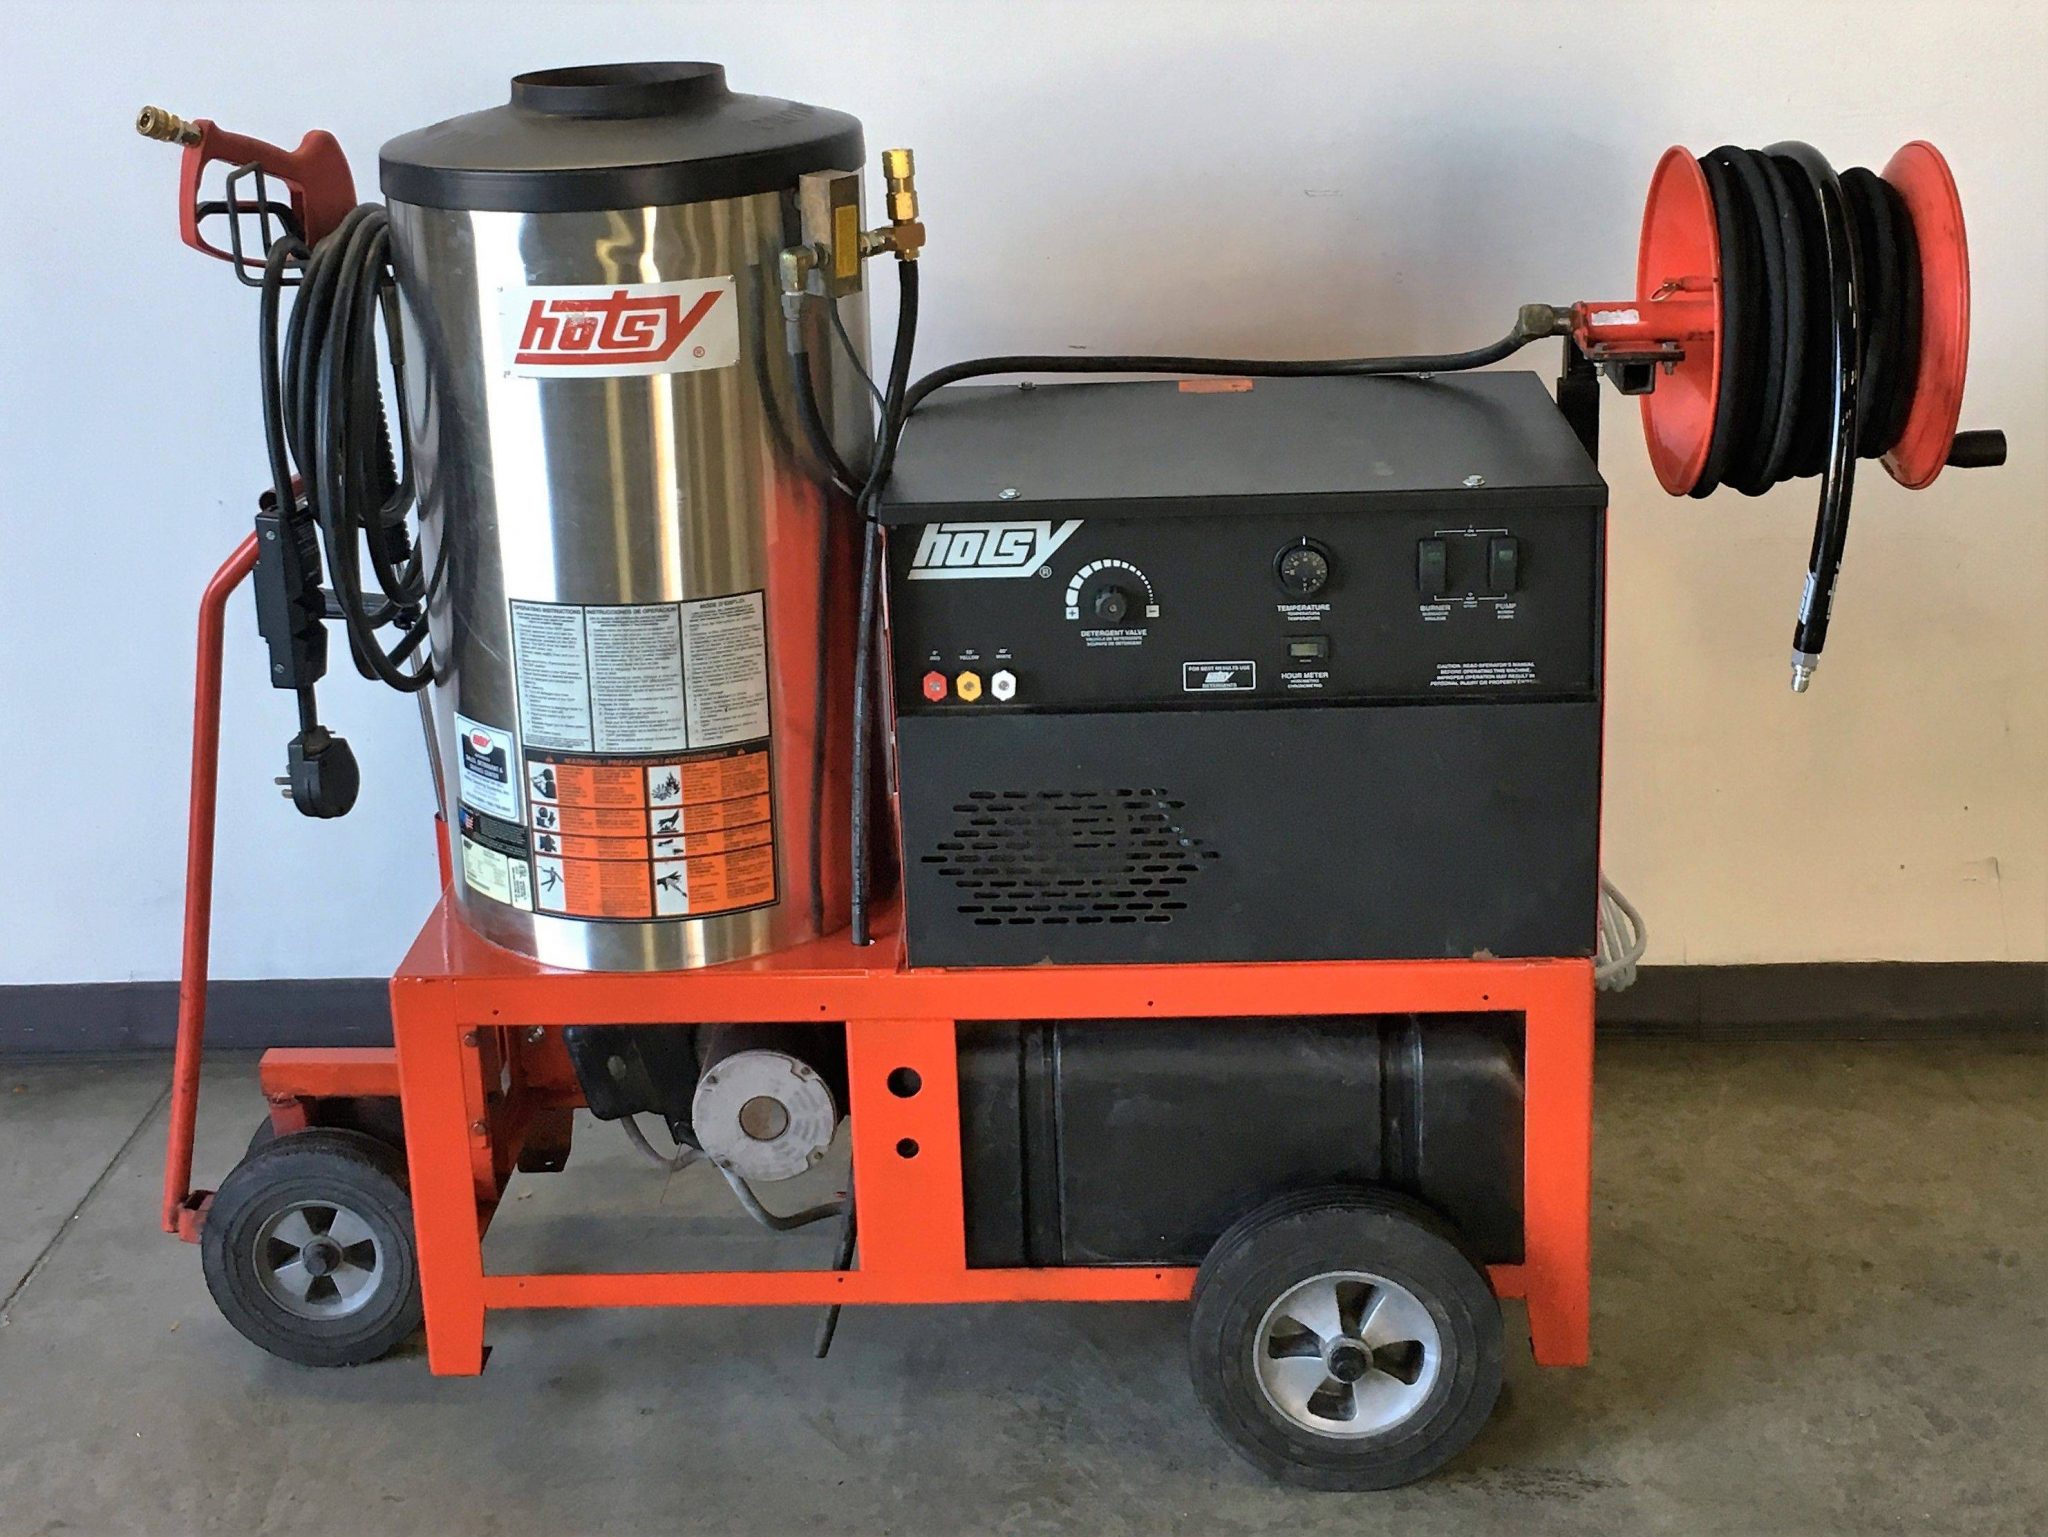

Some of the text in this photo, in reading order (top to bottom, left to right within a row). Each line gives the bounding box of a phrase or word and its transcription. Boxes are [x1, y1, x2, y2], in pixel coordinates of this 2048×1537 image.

[1277, 604, 1331, 612] TEMPERATURE
[1420, 604, 1451, 612] BURNER
[1080, 628, 1147, 638] DETERGENT VALVE
